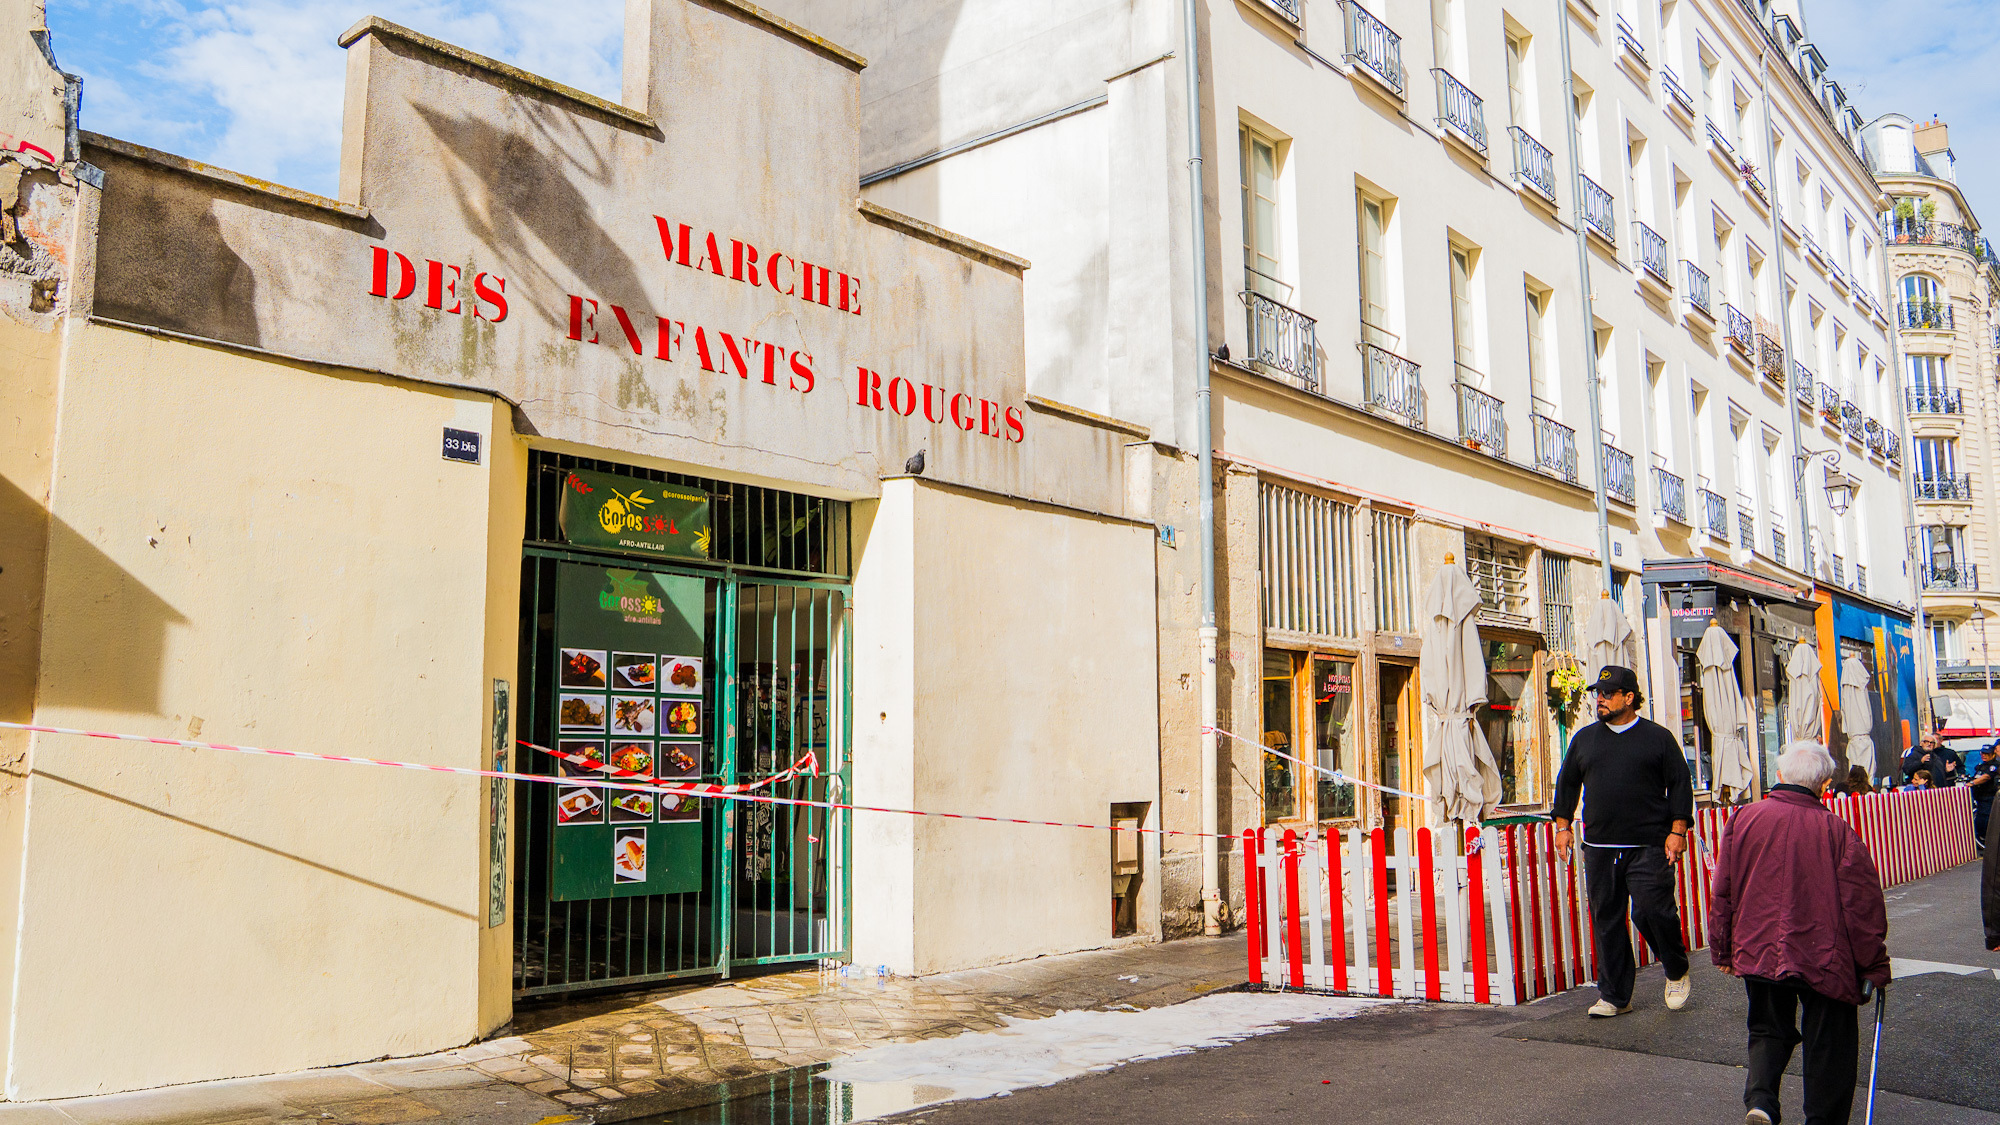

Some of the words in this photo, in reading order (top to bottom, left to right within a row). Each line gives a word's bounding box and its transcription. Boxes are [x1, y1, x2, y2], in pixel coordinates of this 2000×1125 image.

[652, 214, 862, 316] MARCHE
[367, 245, 509, 323] DES
[566, 293, 816, 394] ENFANTS
[856, 365, 1025, 443] ROUGES
[445, 437, 460, 450] 33
[461, 440, 477, 453] bis
[619, 539, 665, 552] AFRO-ANTILLAIS
